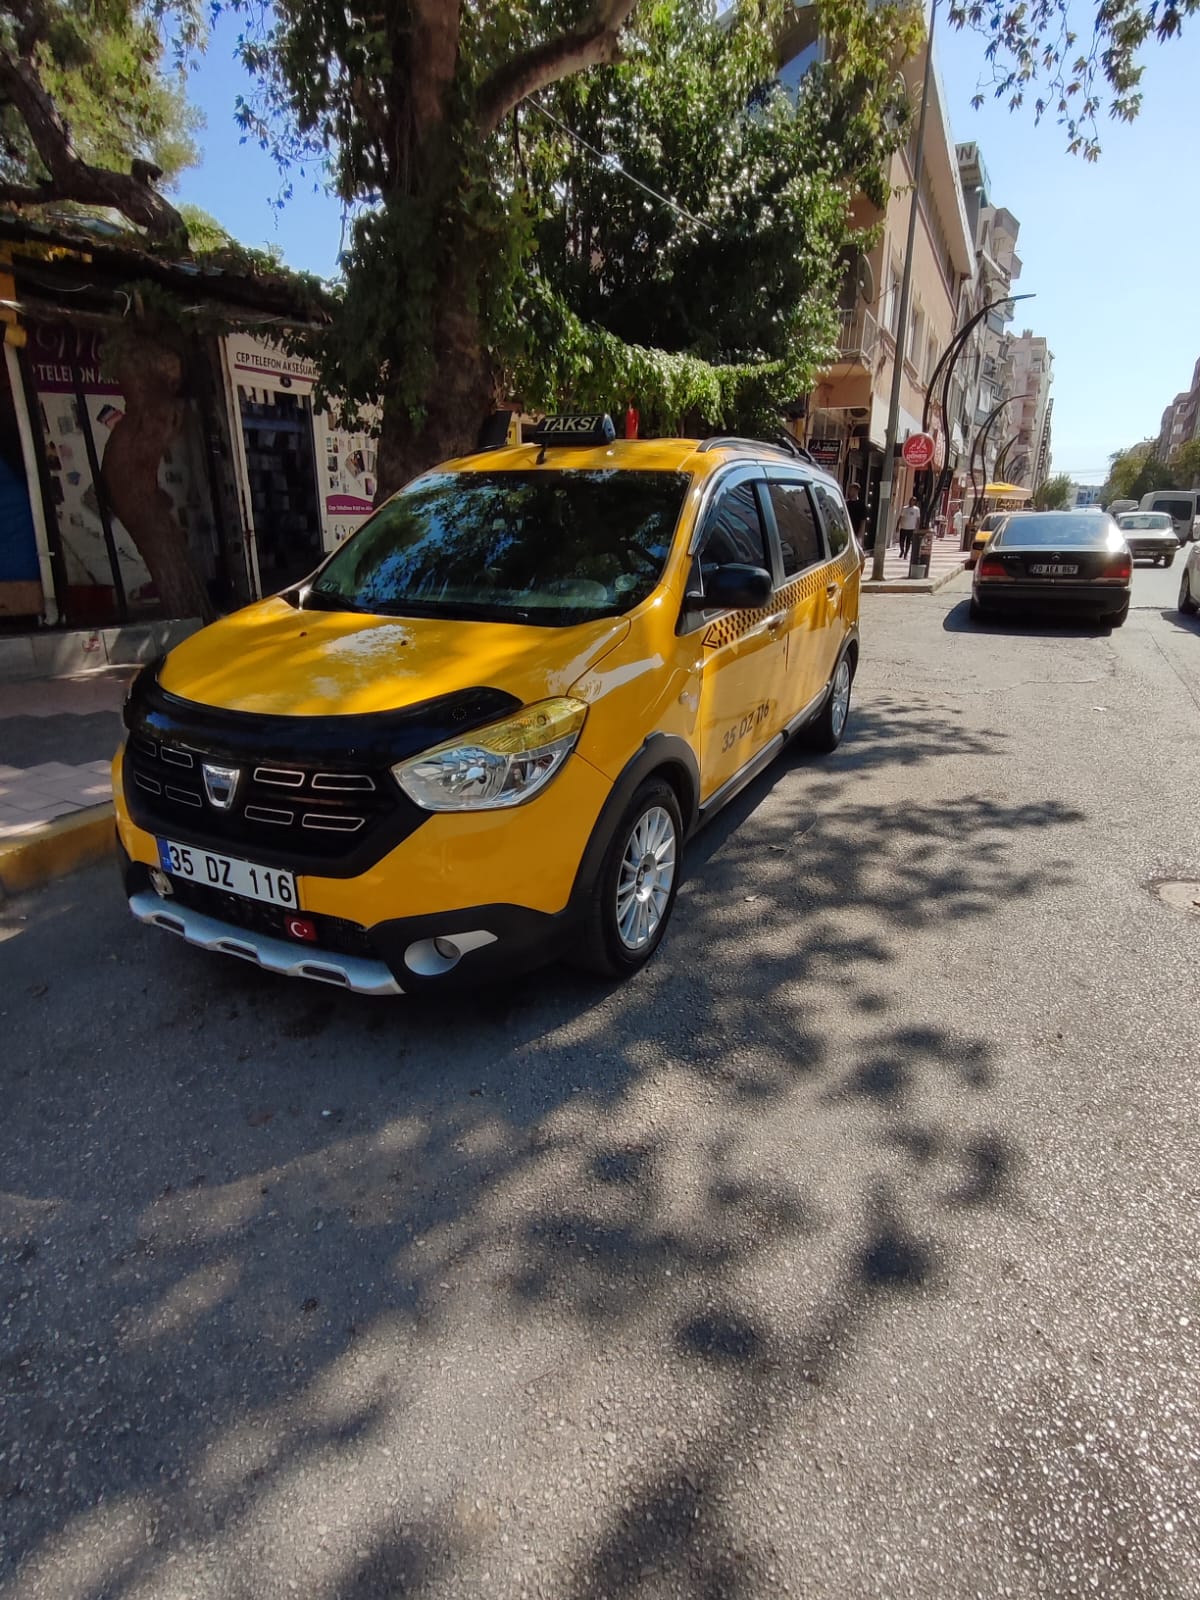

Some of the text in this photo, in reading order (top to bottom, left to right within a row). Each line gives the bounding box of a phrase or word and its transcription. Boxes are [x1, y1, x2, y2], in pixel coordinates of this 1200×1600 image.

[236, 352, 250, 363] CEP
[251, 355, 281, 369] TELEFON
[169, 845, 194, 876] 35
[205, 855, 234, 888] DZ
[249, 867, 292, 903] 116
